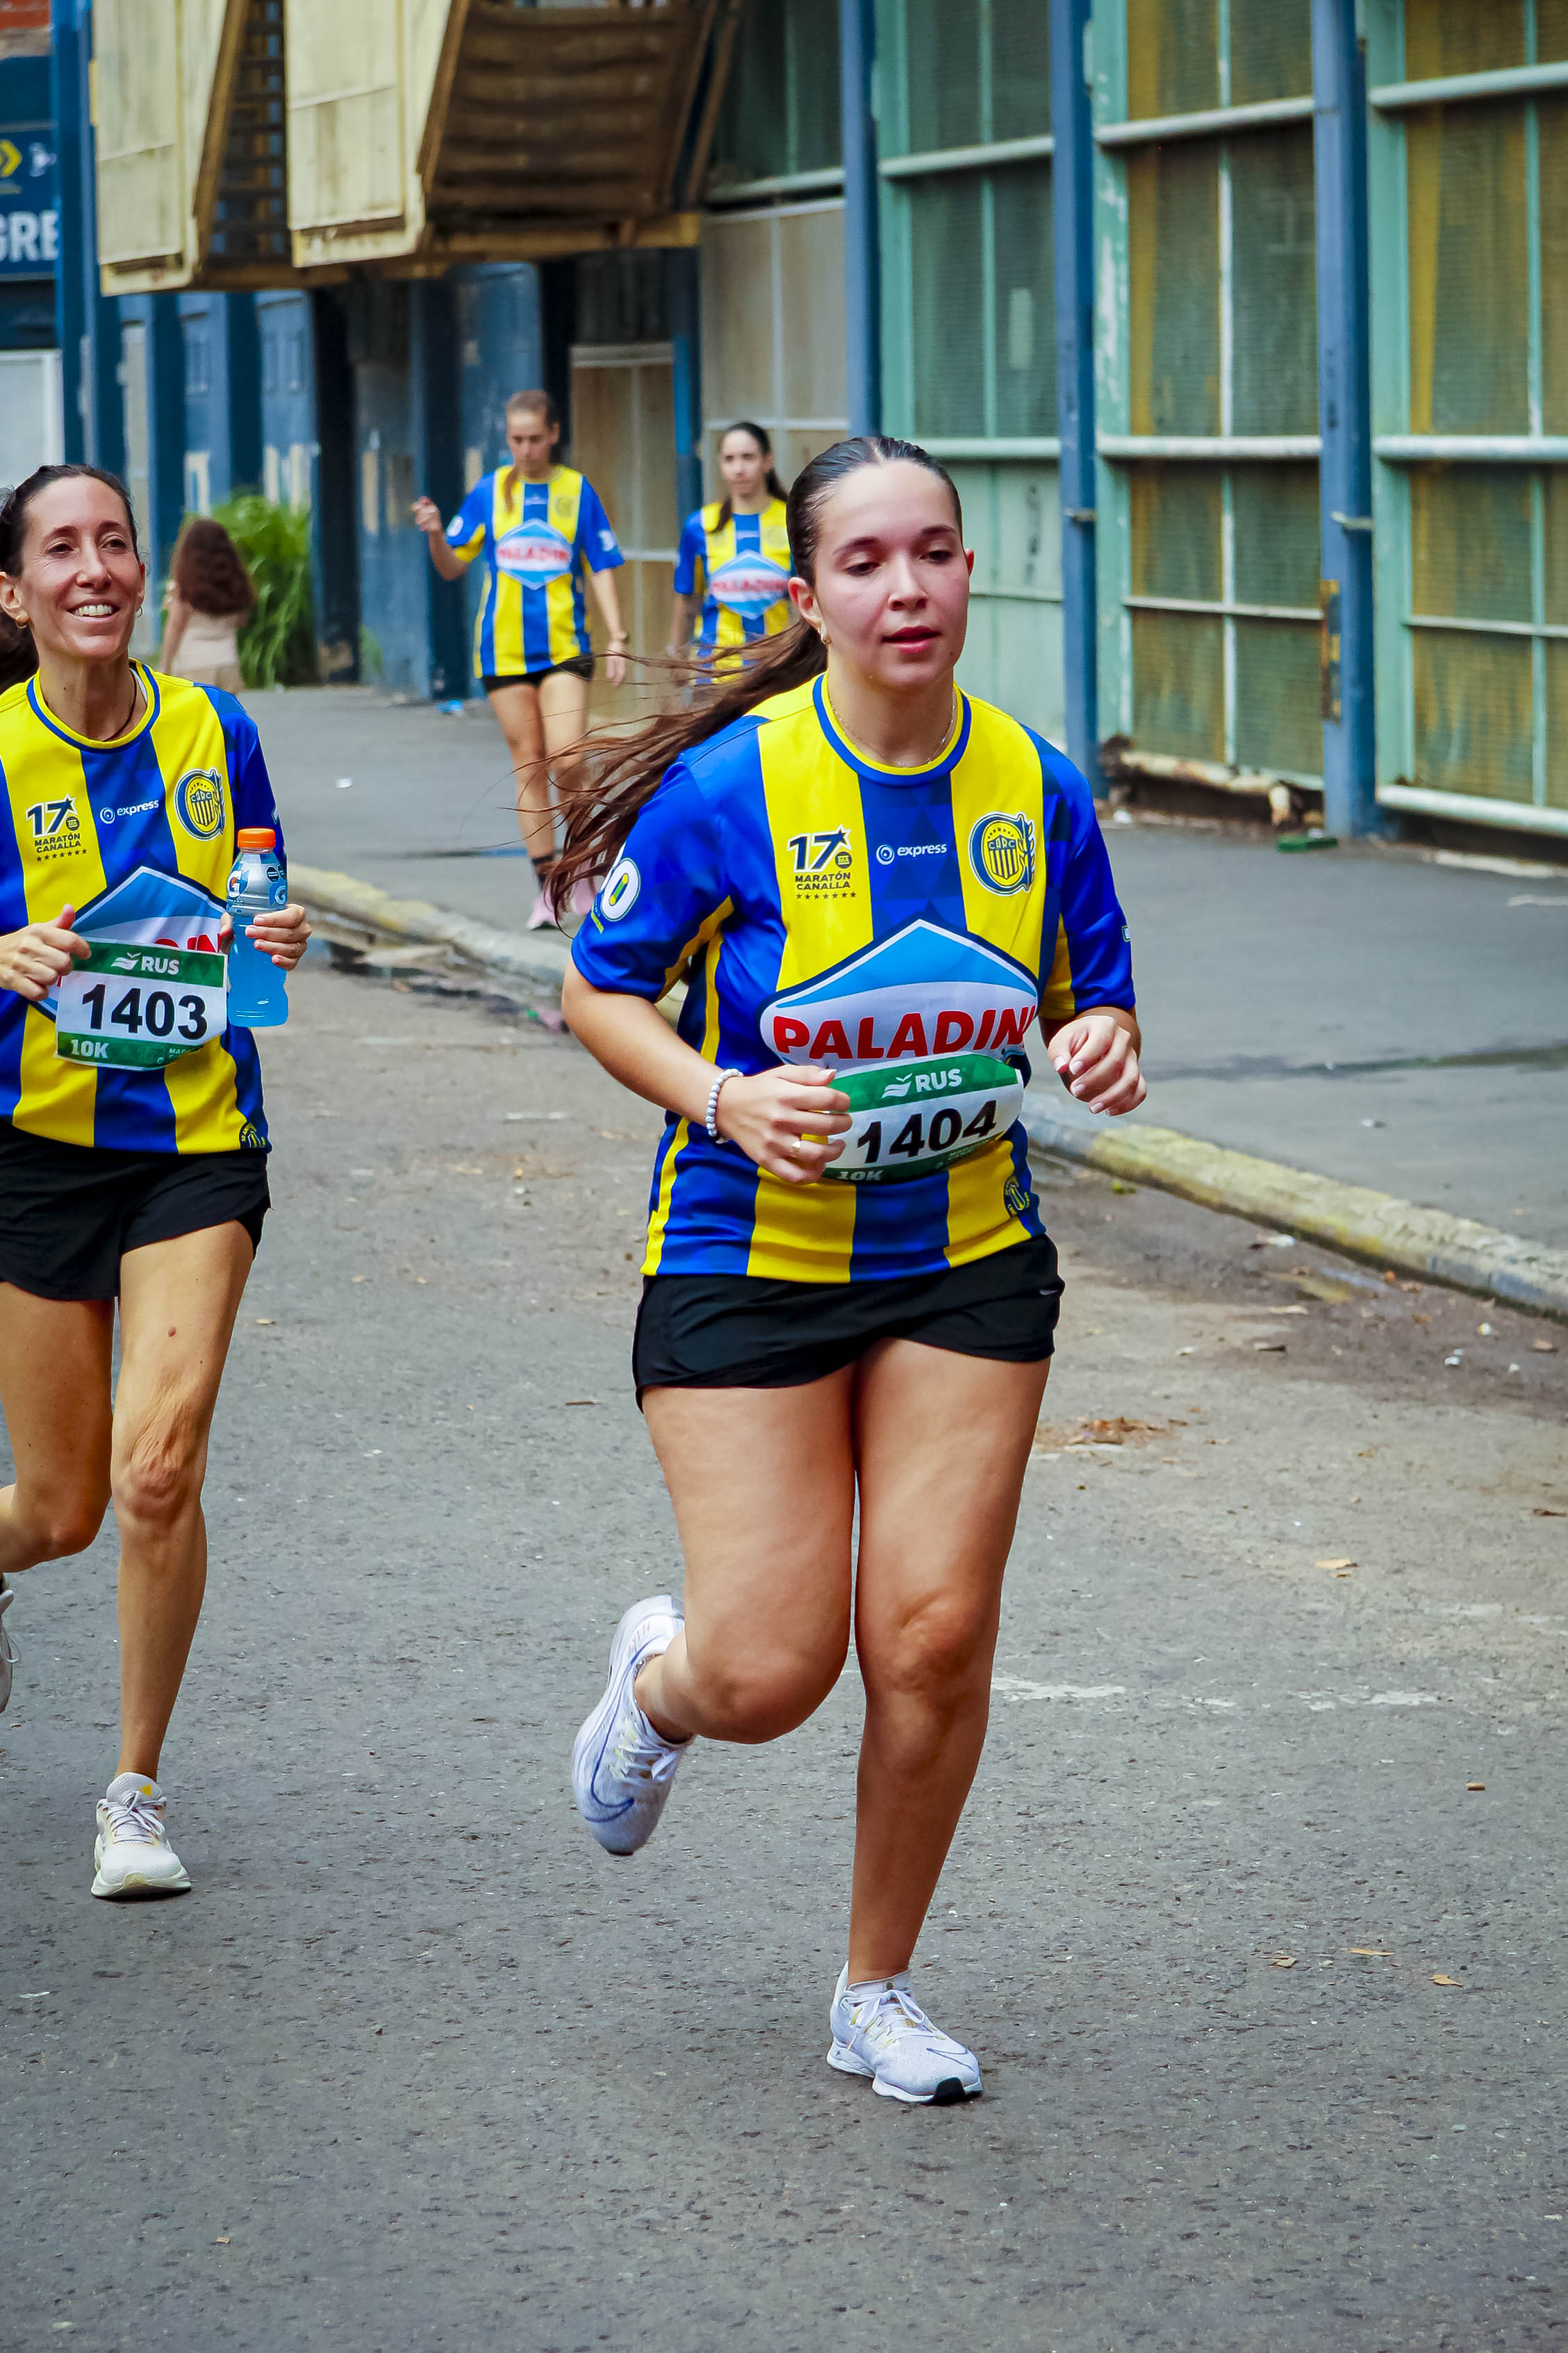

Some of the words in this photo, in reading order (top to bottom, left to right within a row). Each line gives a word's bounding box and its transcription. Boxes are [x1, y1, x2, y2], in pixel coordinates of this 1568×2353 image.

[0, 211, 58, 262] RE
[26, 794, 76, 837] 17
[117, 800, 159, 815] express
[35, 833, 81, 847] MARATÓN
[36, 841, 81, 853] CANALLA
[989, 840, 1016, 849] CARC
[787, 828, 850, 873] 17
[897, 844, 947, 857] express
[795, 871, 851, 883] MARATÓN
[796, 881, 850, 890] CANALLA
[141, 956, 180, 975] RUS
[82, 983, 208, 1040] 1403
[70, 1039, 109, 1058] 10K
[914, 1069, 962, 1093] RUS
[857, 1099, 998, 1164] 1404
[837, 1170, 884, 1181] 10K
